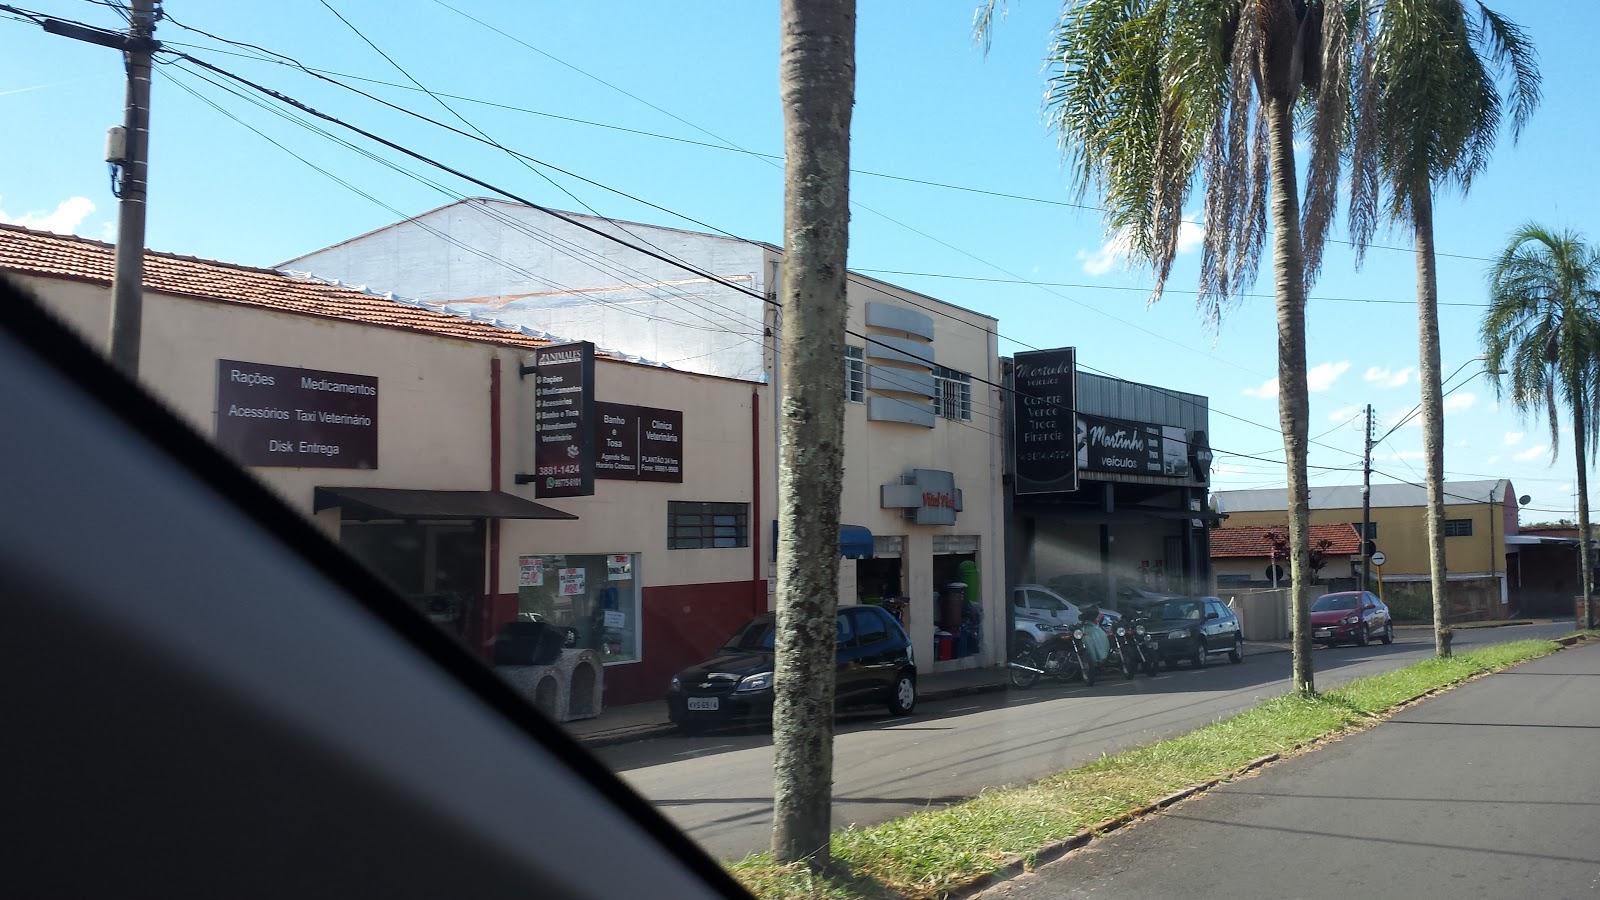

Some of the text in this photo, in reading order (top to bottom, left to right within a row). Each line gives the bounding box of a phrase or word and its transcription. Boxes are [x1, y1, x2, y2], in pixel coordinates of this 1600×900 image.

[231, 369, 376, 395] Rações Medicamentos
[543, 386, 582, 395] Medicamentos
[228, 403, 372, 427] Acessórios Taxi Veterinário
[603, 414, 625, 425] Banho
[652, 419, 672, 431] Clínica
[612, 428, 617, 436] e
[606, 438, 623, 448] Tosa
[1090, 424, 1145, 452] Martinho
[269, 438, 340, 457] Disk Entrega
[539, 464, 579, 475] 3881-1424
